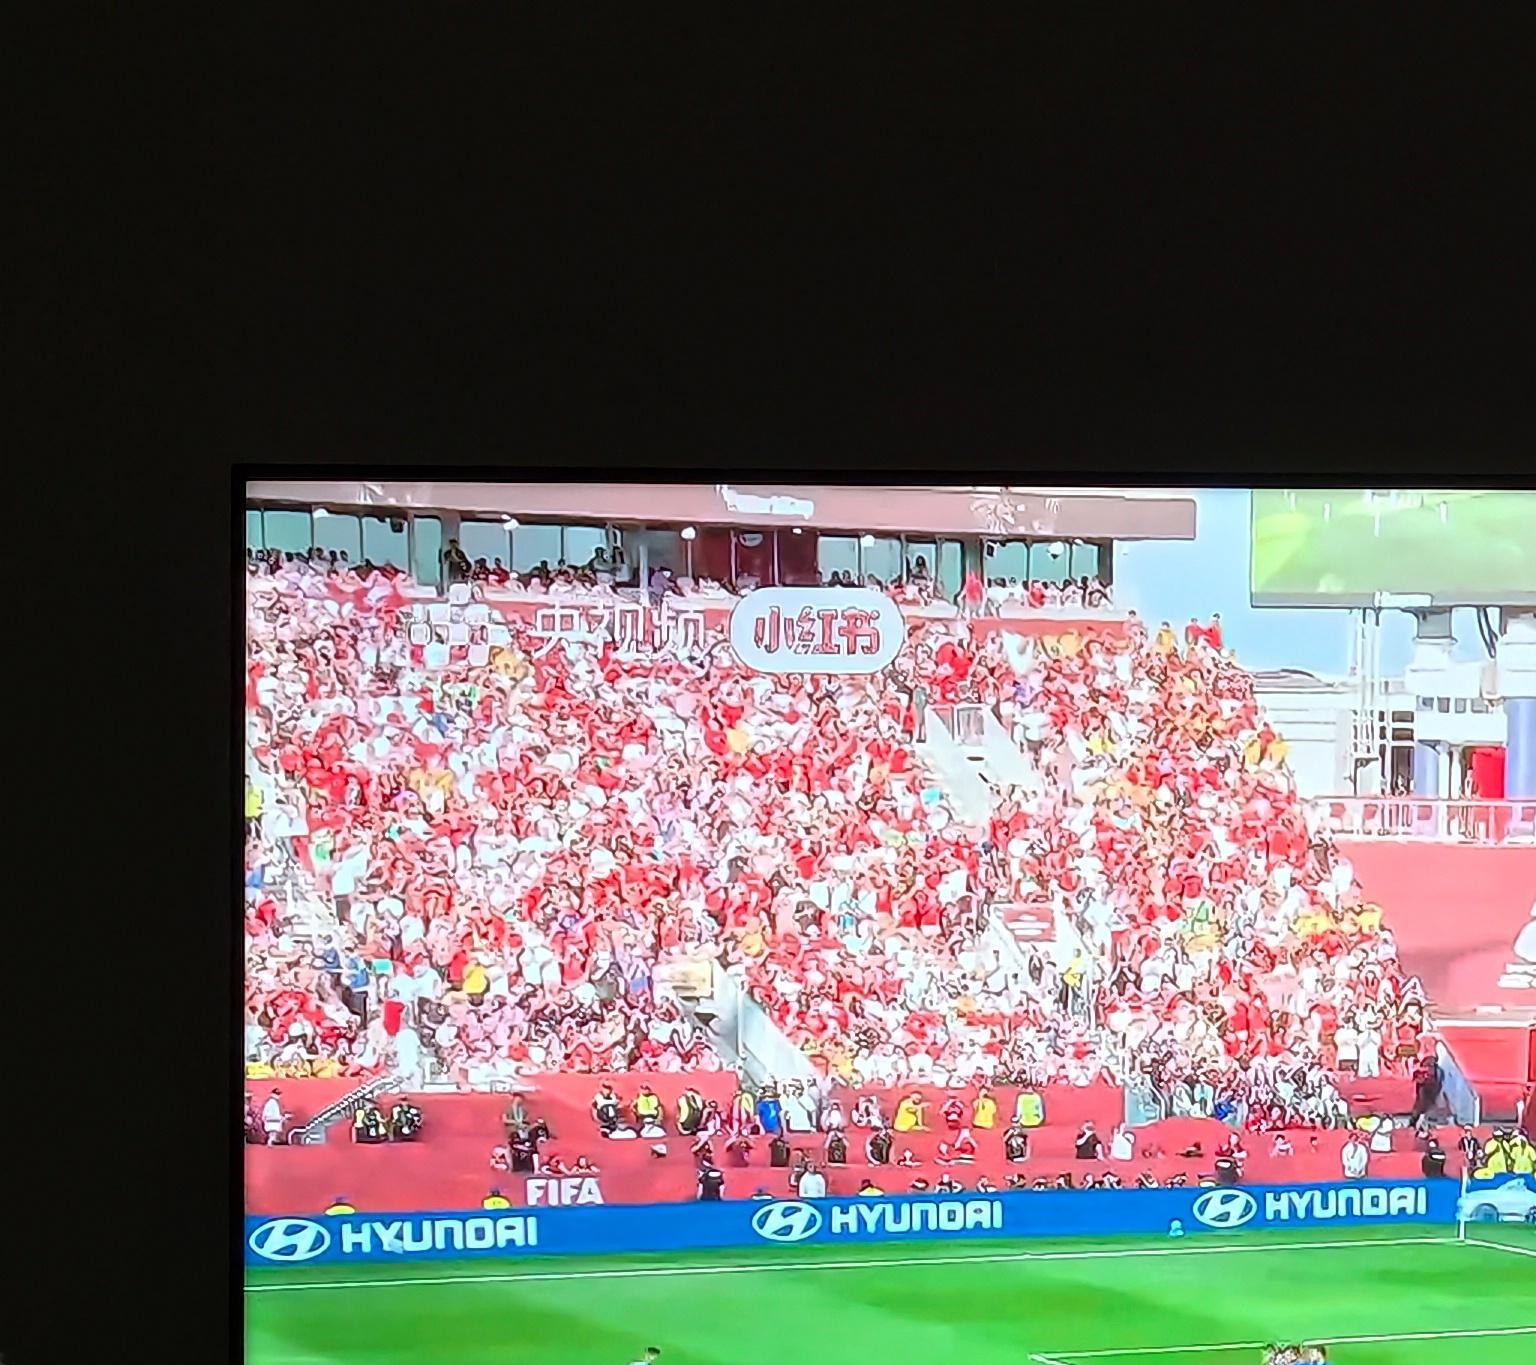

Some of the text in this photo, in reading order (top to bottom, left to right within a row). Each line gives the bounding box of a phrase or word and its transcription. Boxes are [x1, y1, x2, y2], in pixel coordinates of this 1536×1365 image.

[753, 606, 881, 655] 小红书
[526, 1177, 604, 1206] FIFA
[1266, 1187, 1427, 1219] HYUNDAI
[831, 1200, 1002, 1234] HYUNDAI
[342, 1217, 538, 1253] HYUNDAI
